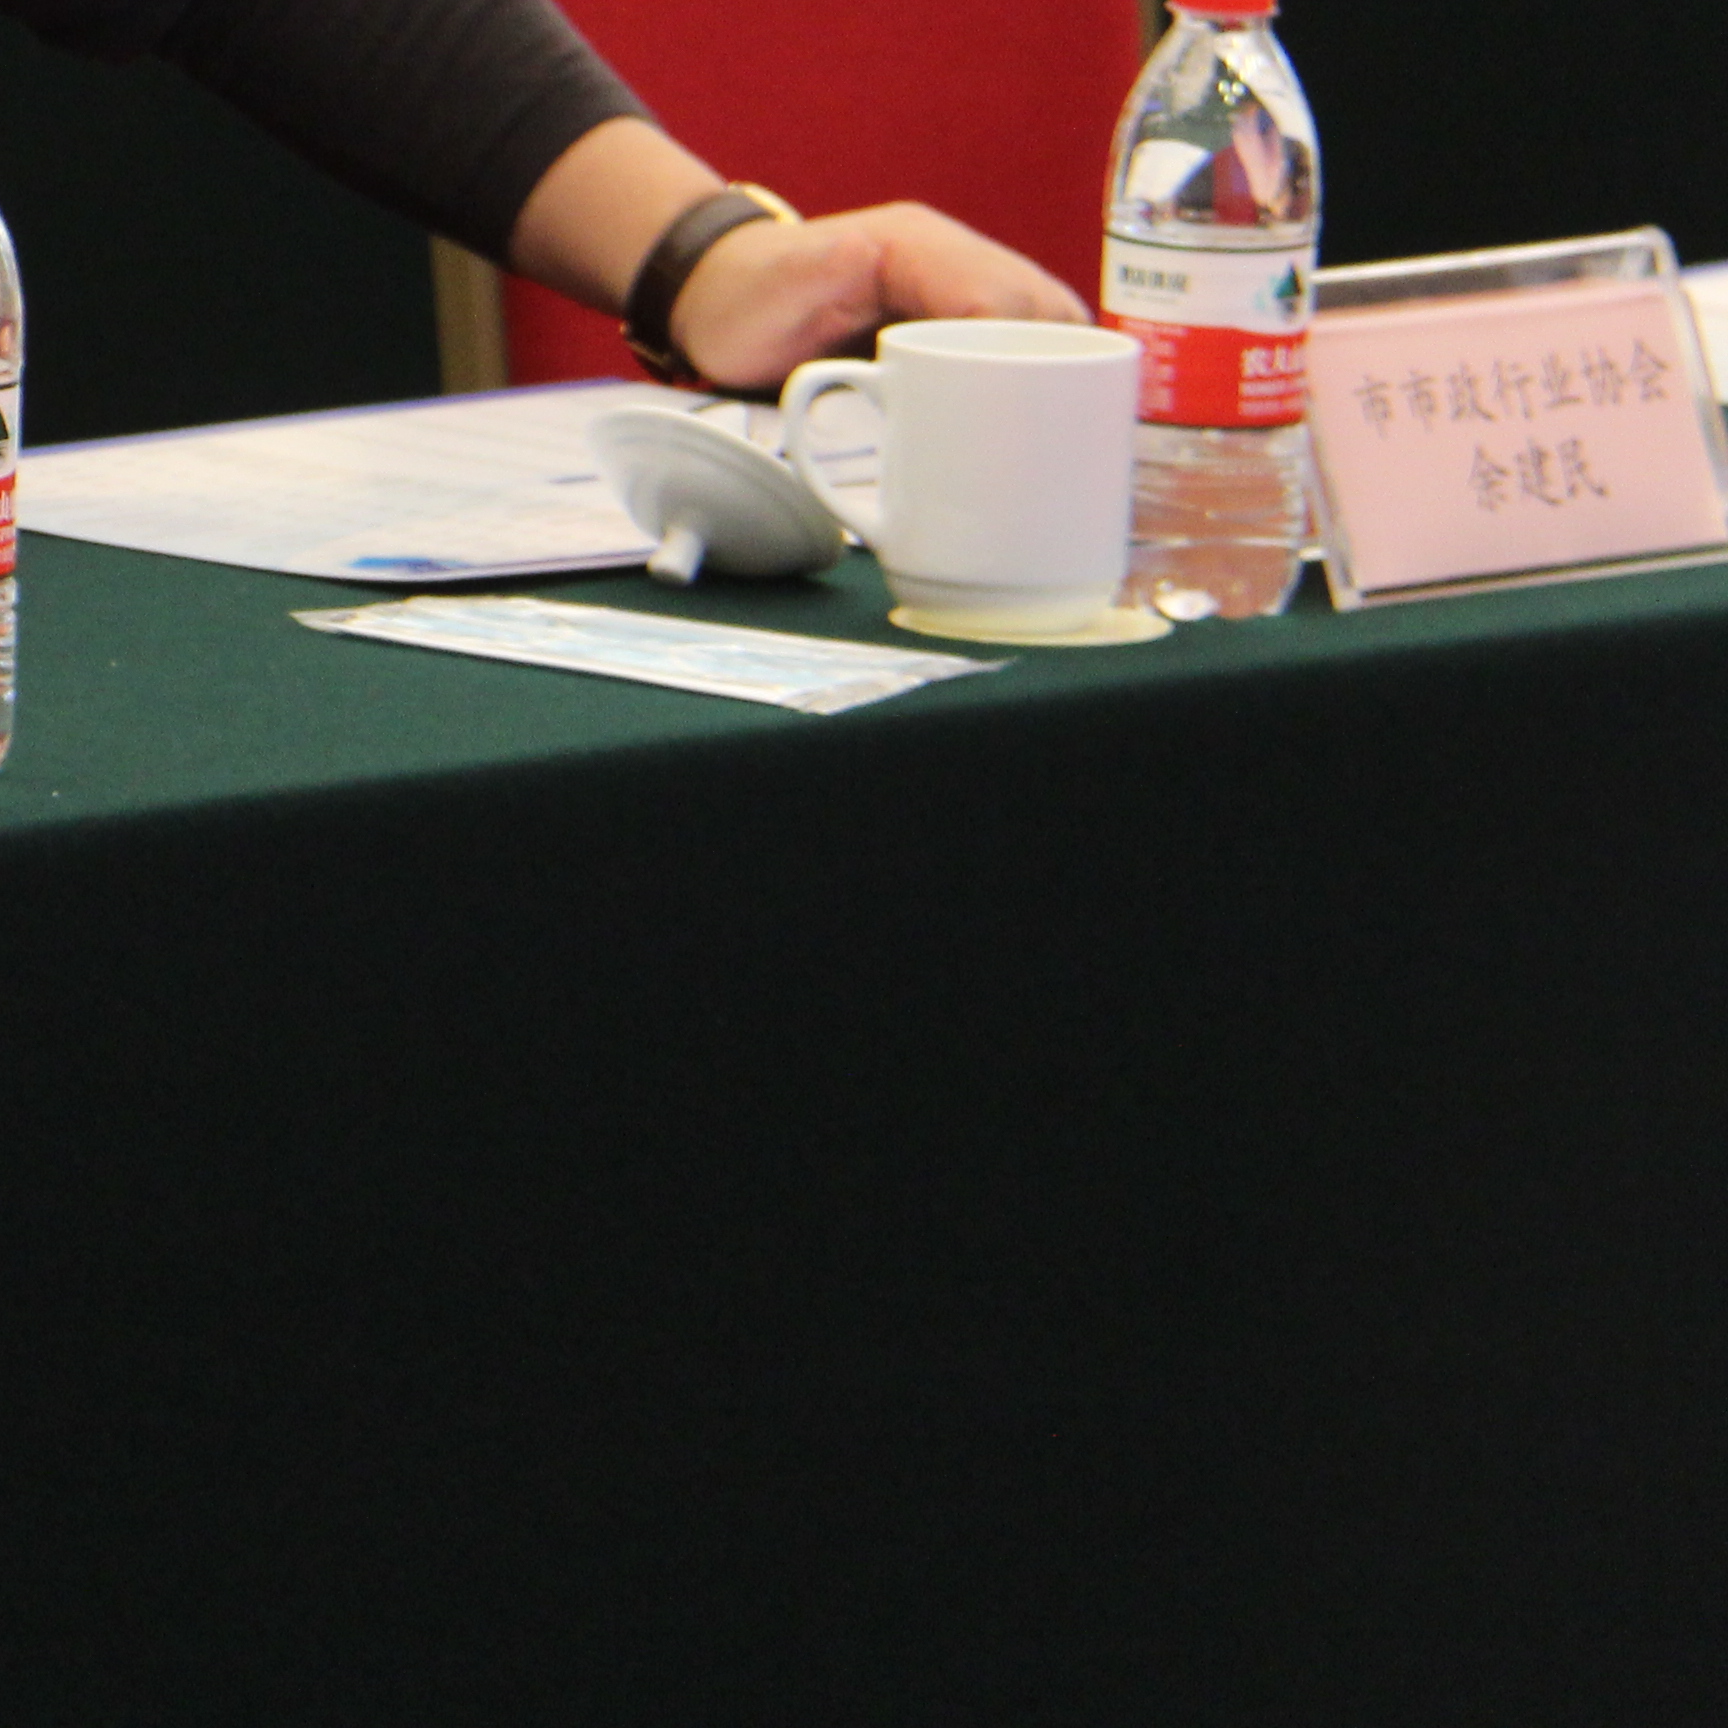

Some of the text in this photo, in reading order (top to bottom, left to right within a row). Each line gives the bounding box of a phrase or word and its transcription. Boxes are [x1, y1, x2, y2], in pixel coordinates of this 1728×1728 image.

[1352, 338, 1671, 441] 市市政行业协会
